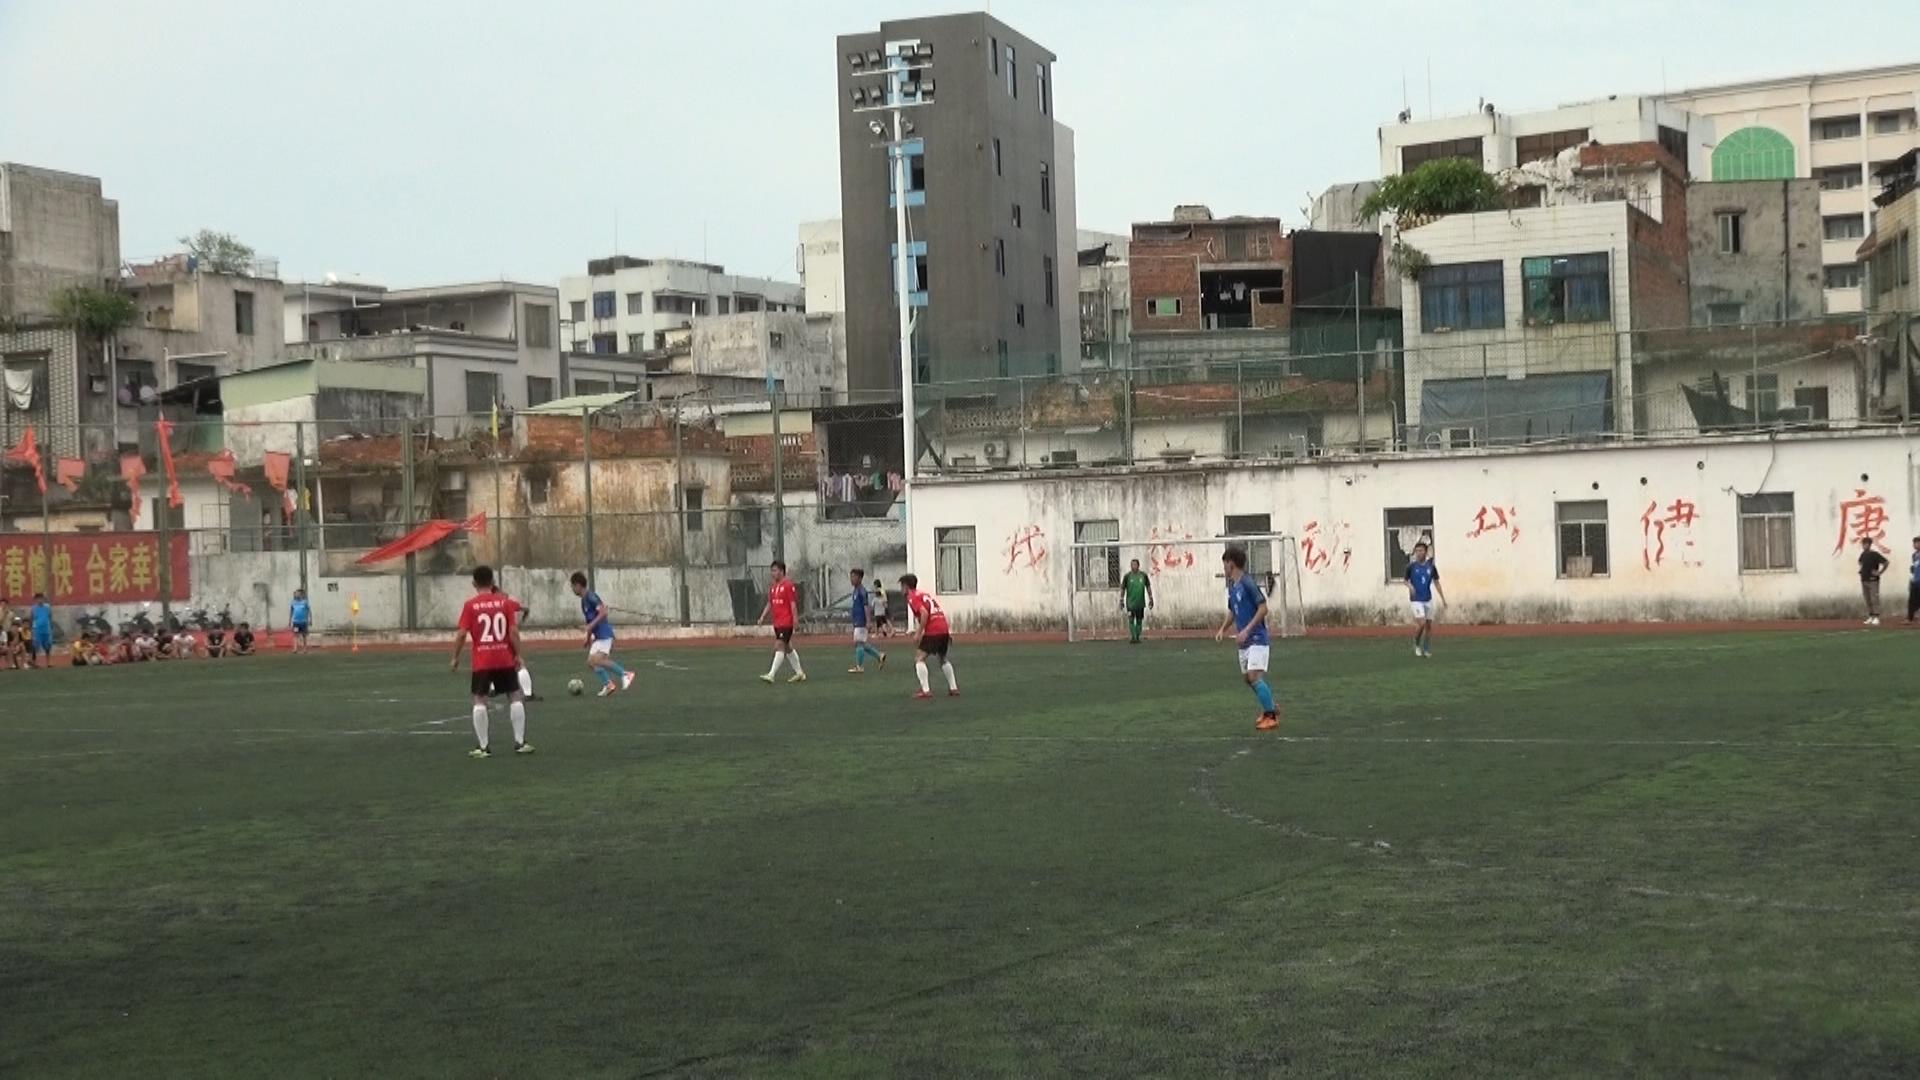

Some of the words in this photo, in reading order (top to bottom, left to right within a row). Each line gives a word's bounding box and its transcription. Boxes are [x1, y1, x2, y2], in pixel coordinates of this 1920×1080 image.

[1832, 489, 1891, 556] 康
[0, 544, 73, 598] 春愉快
[477, 611, 507, 642] 20
